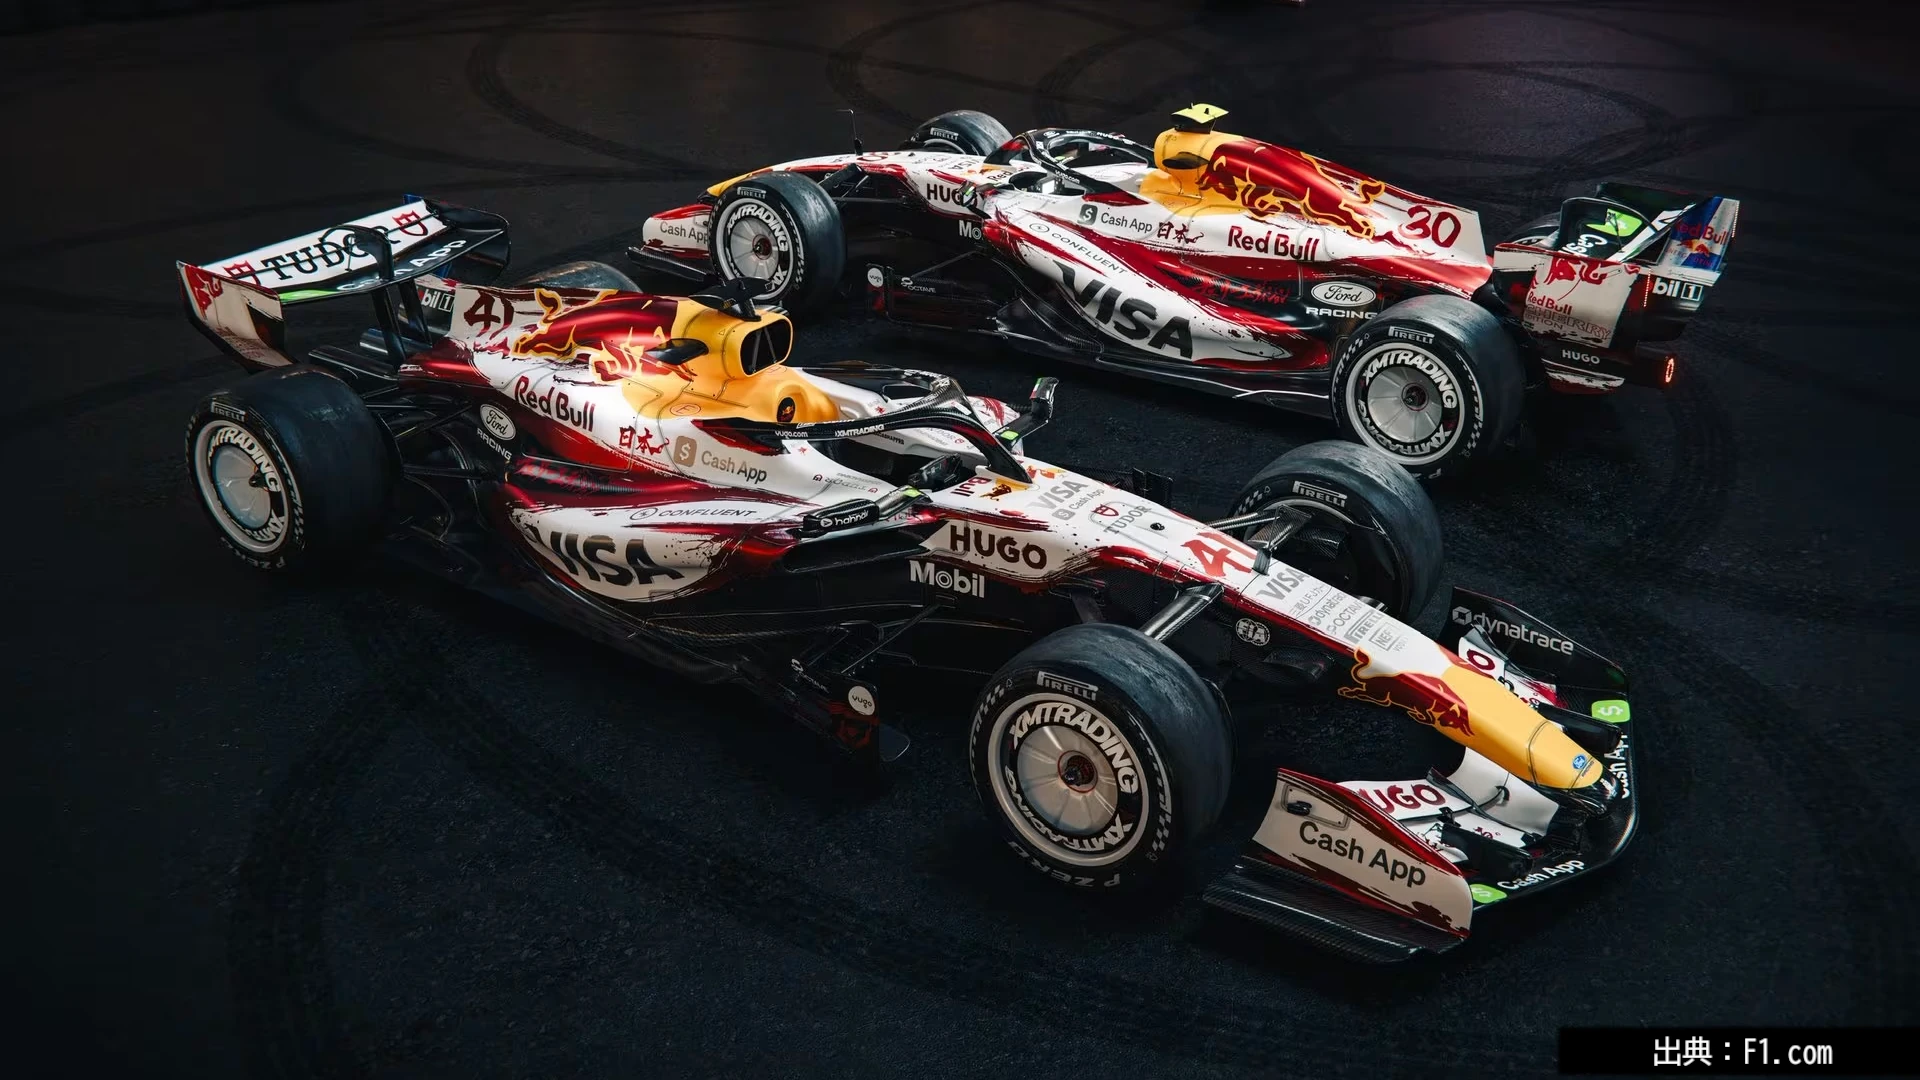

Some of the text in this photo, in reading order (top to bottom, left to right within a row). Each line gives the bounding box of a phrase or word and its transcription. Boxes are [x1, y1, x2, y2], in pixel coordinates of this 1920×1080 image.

[736, 186, 766, 199] PIRELLI
[926, 183, 978, 207] HUG
[659, 220, 687, 238] Cash
[726, 203, 789, 252] XMTRADING
[1100, 211, 1128, 228] Cash
[1129, 217, 1153, 234] App
[1156, 222, 1205, 244] 日本
[1400, 204, 1462, 248] 30
[1702, 225, 1729, 245] Bull
[410, 240, 467, 267] App
[1051, 232, 1128, 275] CONFLUENT
[1227, 225, 1319, 262] Red Bull
[421, 289, 441, 309] bil
[1323, 284, 1361, 303] Ford
[1653, 277, 1680, 298] bil
[463, 288, 515, 340] 41
[1052, 259, 1193, 359] VISA
[1305, 307, 1378, 320] RACING
[1528, 291, 1573, 316] Red Bull
[1388, 325, 1435, 345] PIRELLI
[1561, 349, 1601, 364] HUGO
[1362, 350, 1458, 409] XMTRADING
[514, 375, 596, 432] Red Bull
[486, 409, 508, 436] Ford
[476, 428, 512, 461] RACING
[619, 425, 670, 456] 日本
[700, 449, 735, 474] Cash
[736, 463, 767, 485] App
[950, 476, 992, 498] Bull
[1028, 480, 1089, 511] VISA
[1292, 480, 1347, 508] PIRELLI
[659, 507, 760, 519] CONFLUENT
[1103, 505, 1152, 535] TUDOR
[524, 522, 686, 587] VISA
[950, 524, 1047, 570] HUGO
[1181, 531, 1257, 577] 41
[909, 559, 985, 599] Mobil
[1257, 567, 1309, 600] VISA
[1316, 590, 1349, 619] dynatrac
[1333, 601, 1365, 627] OCTAV
[1473, 612, 1574, 656] dynatrace
[1036, 670, 1099, 701] PIRELLI
[852, 694, 873, 709] vugo
[1010, 702, 1139, 794] XMTRADING
[1005, 764, 1133, 852] XMTRADING
[1358, 783, 1446, 813] UGO
[1299, 821, 1426, 888] Cash App
[1497, 858, 1585, 891] Cash App
